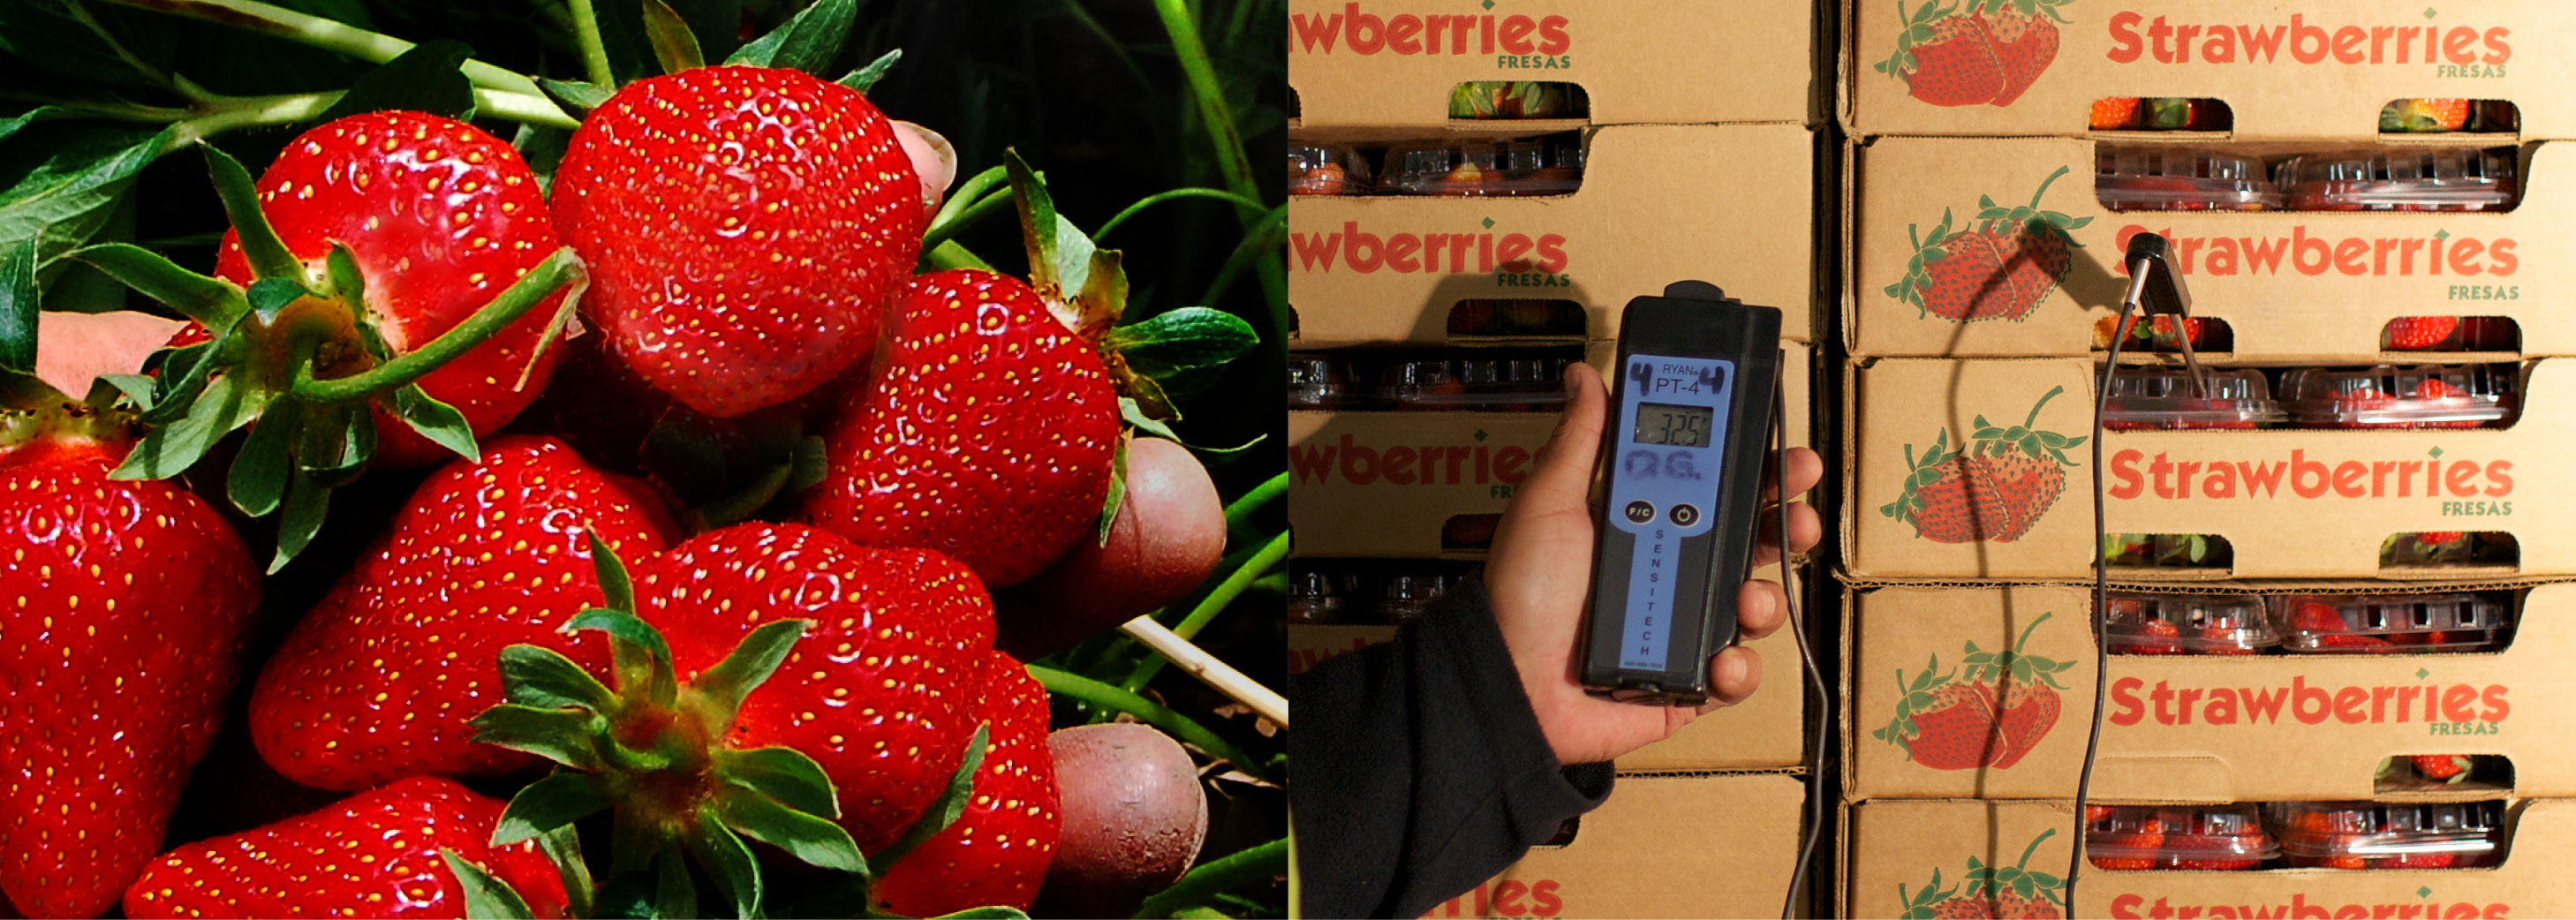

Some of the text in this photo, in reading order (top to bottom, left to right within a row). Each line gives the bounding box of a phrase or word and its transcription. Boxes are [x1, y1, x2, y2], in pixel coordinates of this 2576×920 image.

[1288, 0, 1570, 56] wberries
[2107, 7, 2512, 64] Strawberries
[1498, 55, 1571, 69] FRESAS
[2437, 64, 2507, 78] FRESAS
[1288, 217, 1568, 274] wberries
[2114, 224, 2519, 275] Srawberries
[1498, 273, 1570, 288] FRESAS
[2449, 285, 2519, 300] FRESAS
[1630, 362, 1653, 396] 4
[1656, 378, 1700, 395] PT-4
[1699, 366, 1725, 396] 4
[1288, 429, 1546, 485] wberrie
[2109, 446, 2514, 500] Strawberries
[1628, 507, 1651, 517] F/C
[2442, 501, 2512, 516] FRESAS
[1640, 530, 1664, 656] SENSITECH
[2109, 668, 2510, 726] Strawberries
[2430, 721, 2499, 735] FRESAS
